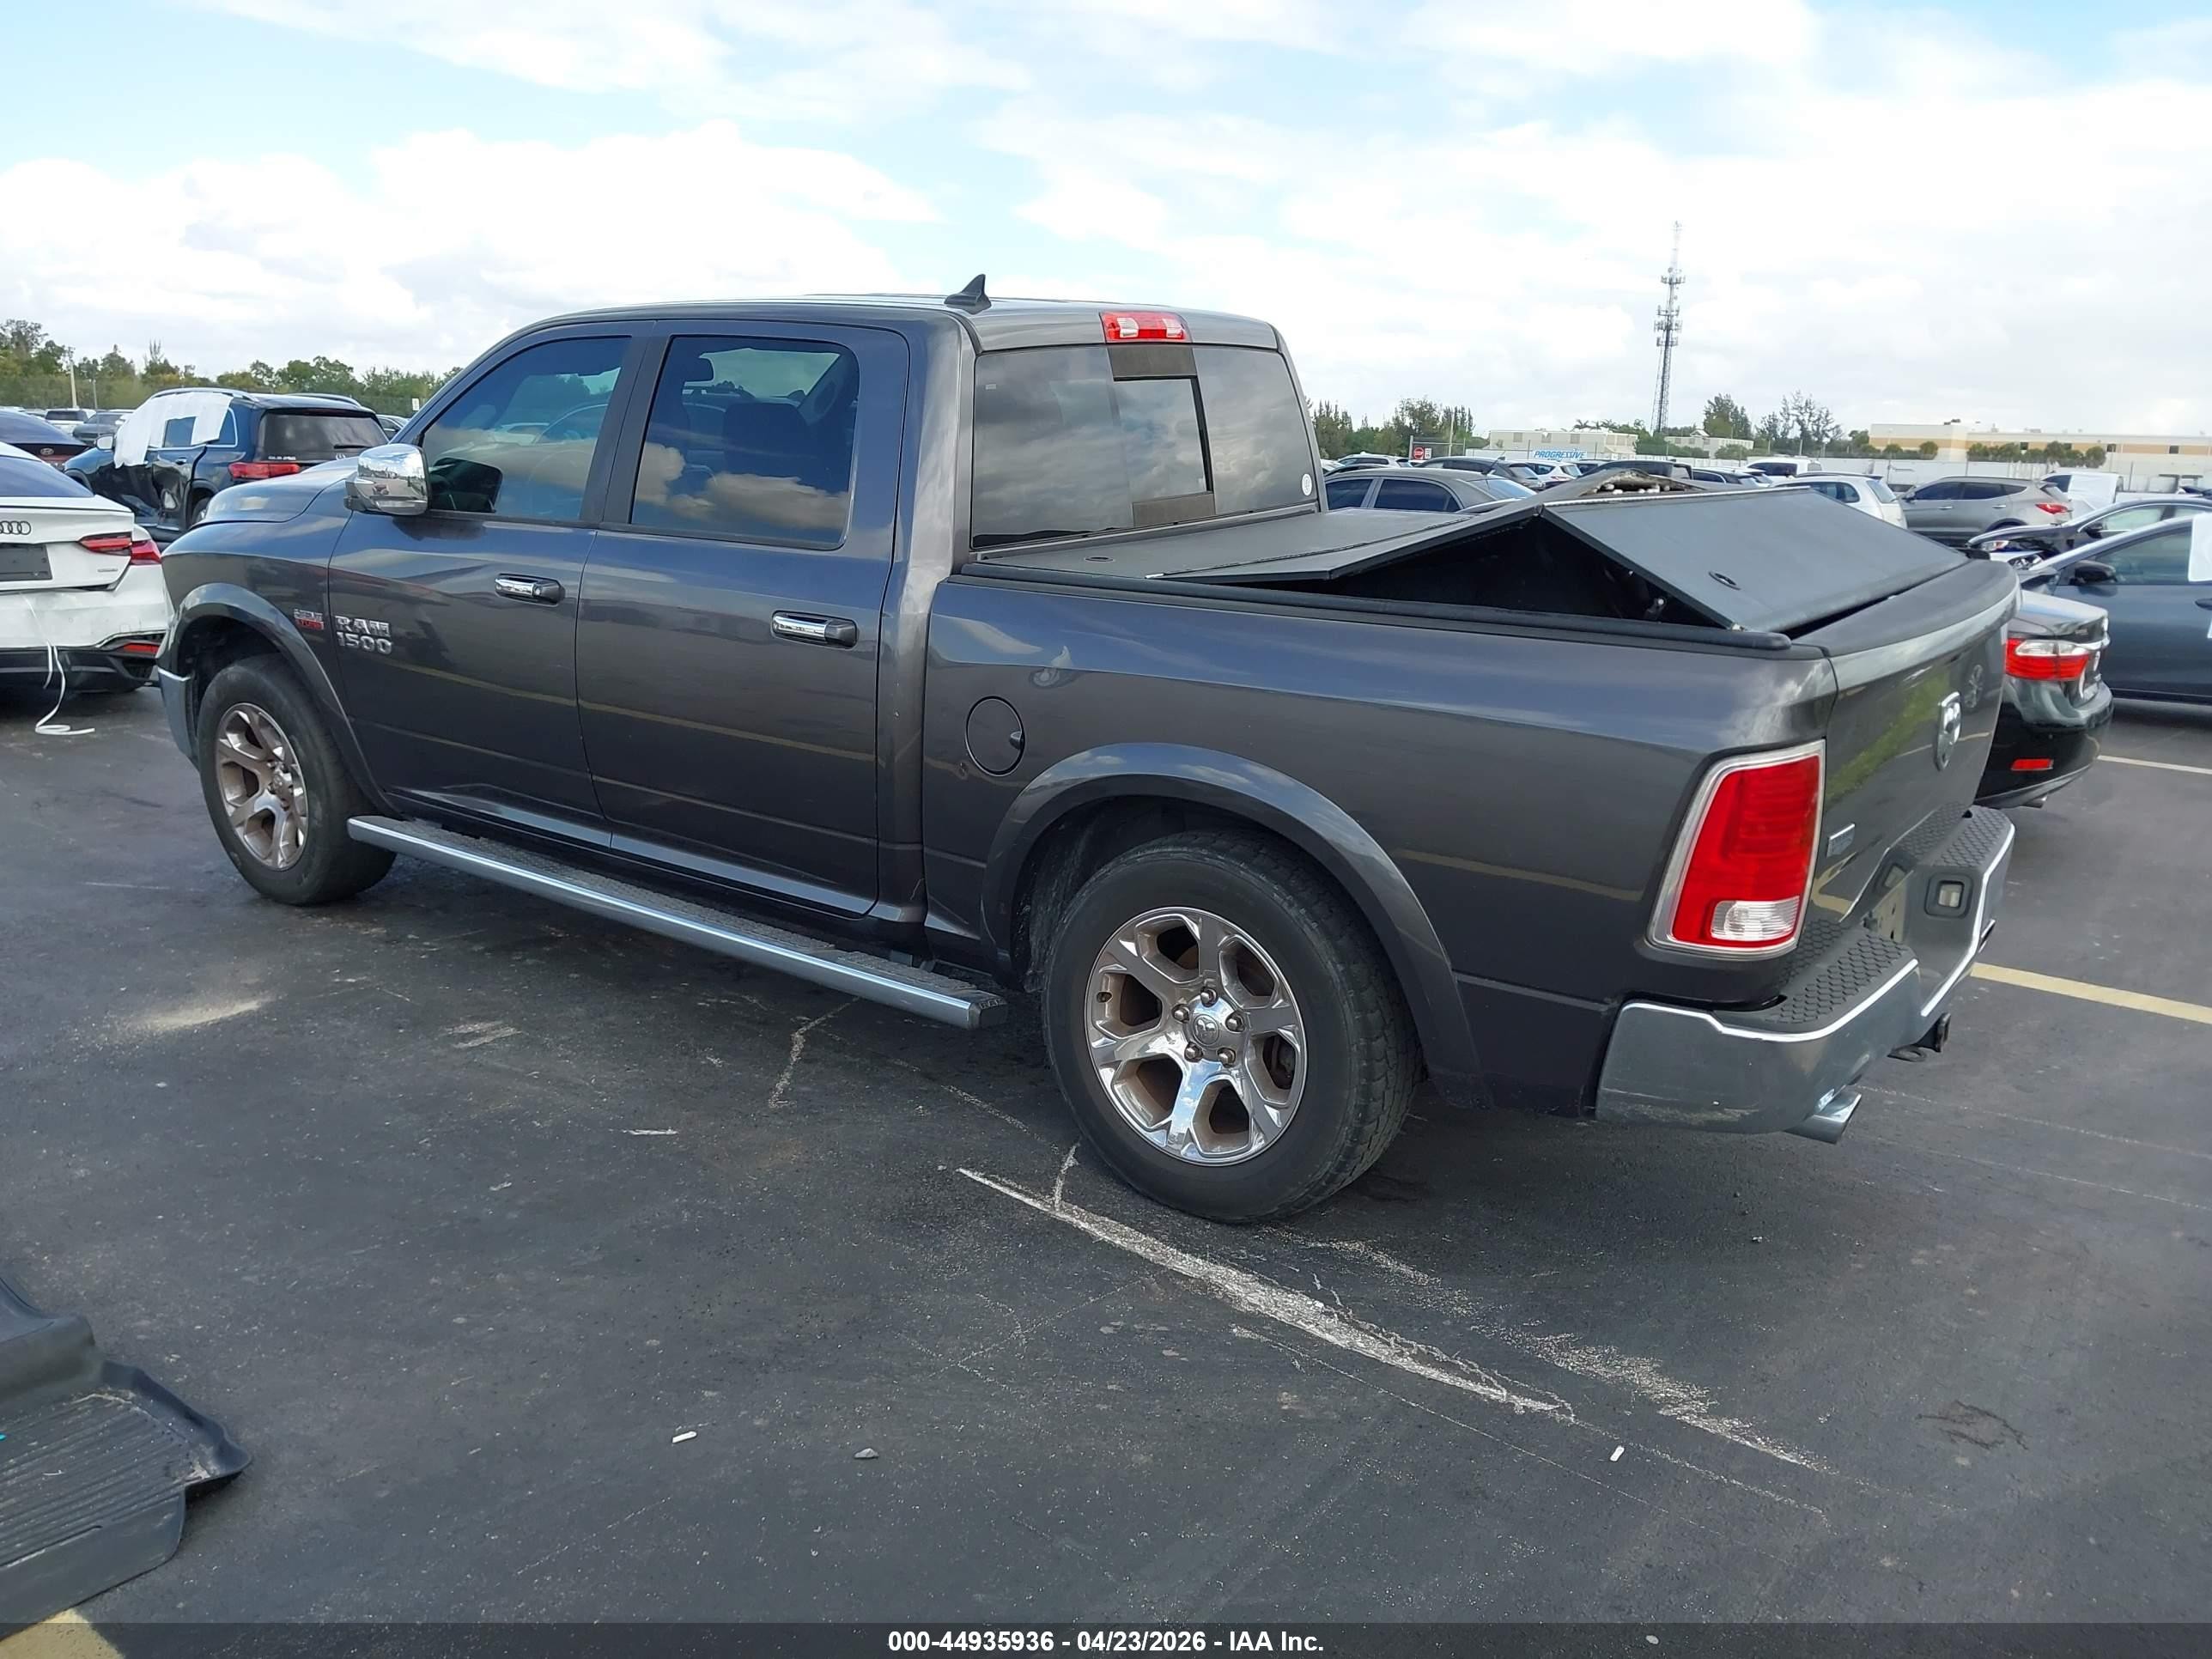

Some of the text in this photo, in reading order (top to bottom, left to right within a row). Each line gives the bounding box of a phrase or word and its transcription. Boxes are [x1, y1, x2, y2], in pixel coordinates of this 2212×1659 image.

[1534, 450, 1586, 459] PROGRESSIVE
[335, 615, 391, 637] RAM
[337, 631, 392, 654] 1500
